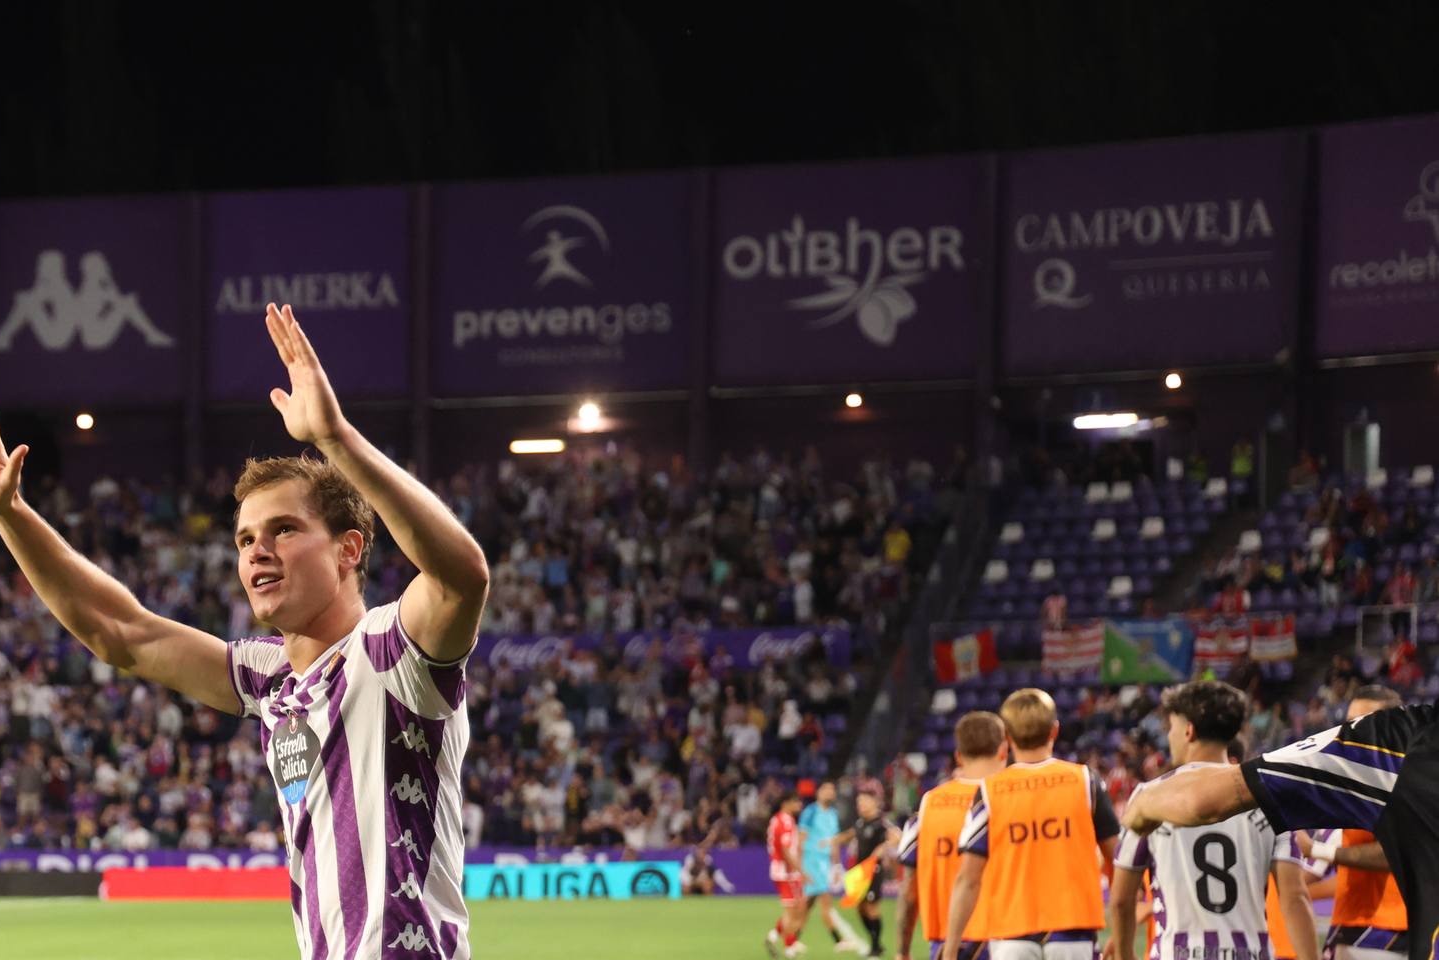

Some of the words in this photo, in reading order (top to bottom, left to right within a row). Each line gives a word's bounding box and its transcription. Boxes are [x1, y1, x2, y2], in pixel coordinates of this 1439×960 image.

[1013, 196, 1274, 253] CAMPOVEJA
[1329, 247, 1439, 290] recolet
[215, 272, 400, 314] ALIMERKA
[453, 302, 672, 349] prevenges
[275, 732, 309, 759] Estrella
[280, 755, 308, 782] Galicia
[1009, 816, 1071, 845] DIGI
[463, 871, 609, 898] ALIGA
[1193, 832, 1239, 914] 8
